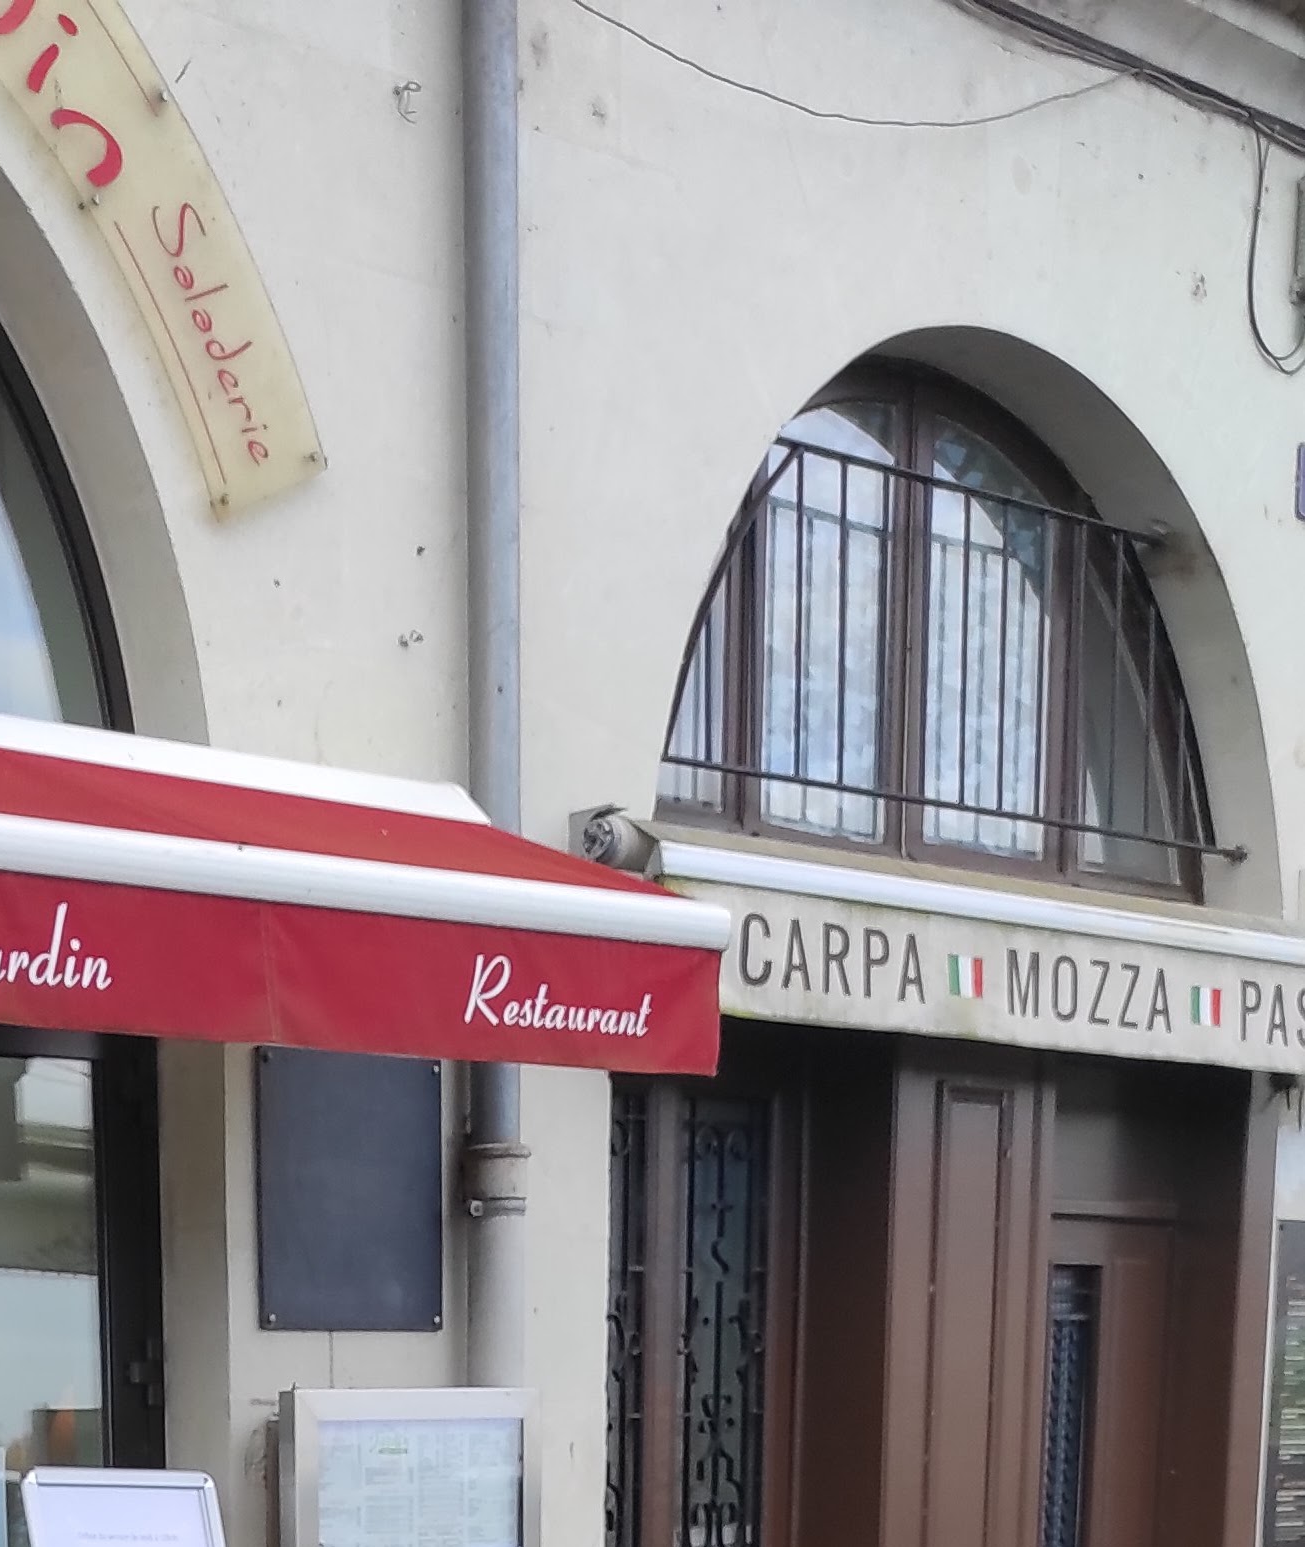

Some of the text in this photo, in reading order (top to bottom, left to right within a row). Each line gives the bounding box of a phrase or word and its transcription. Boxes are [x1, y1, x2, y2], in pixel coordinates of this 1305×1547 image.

[151, 202, 270, 467] Saladerie
[463, 954, 653, 1038] Restaurant
[739, 912, 926, 1005] CARPA
[1007, 947, 1172, 1034] MOZZA
